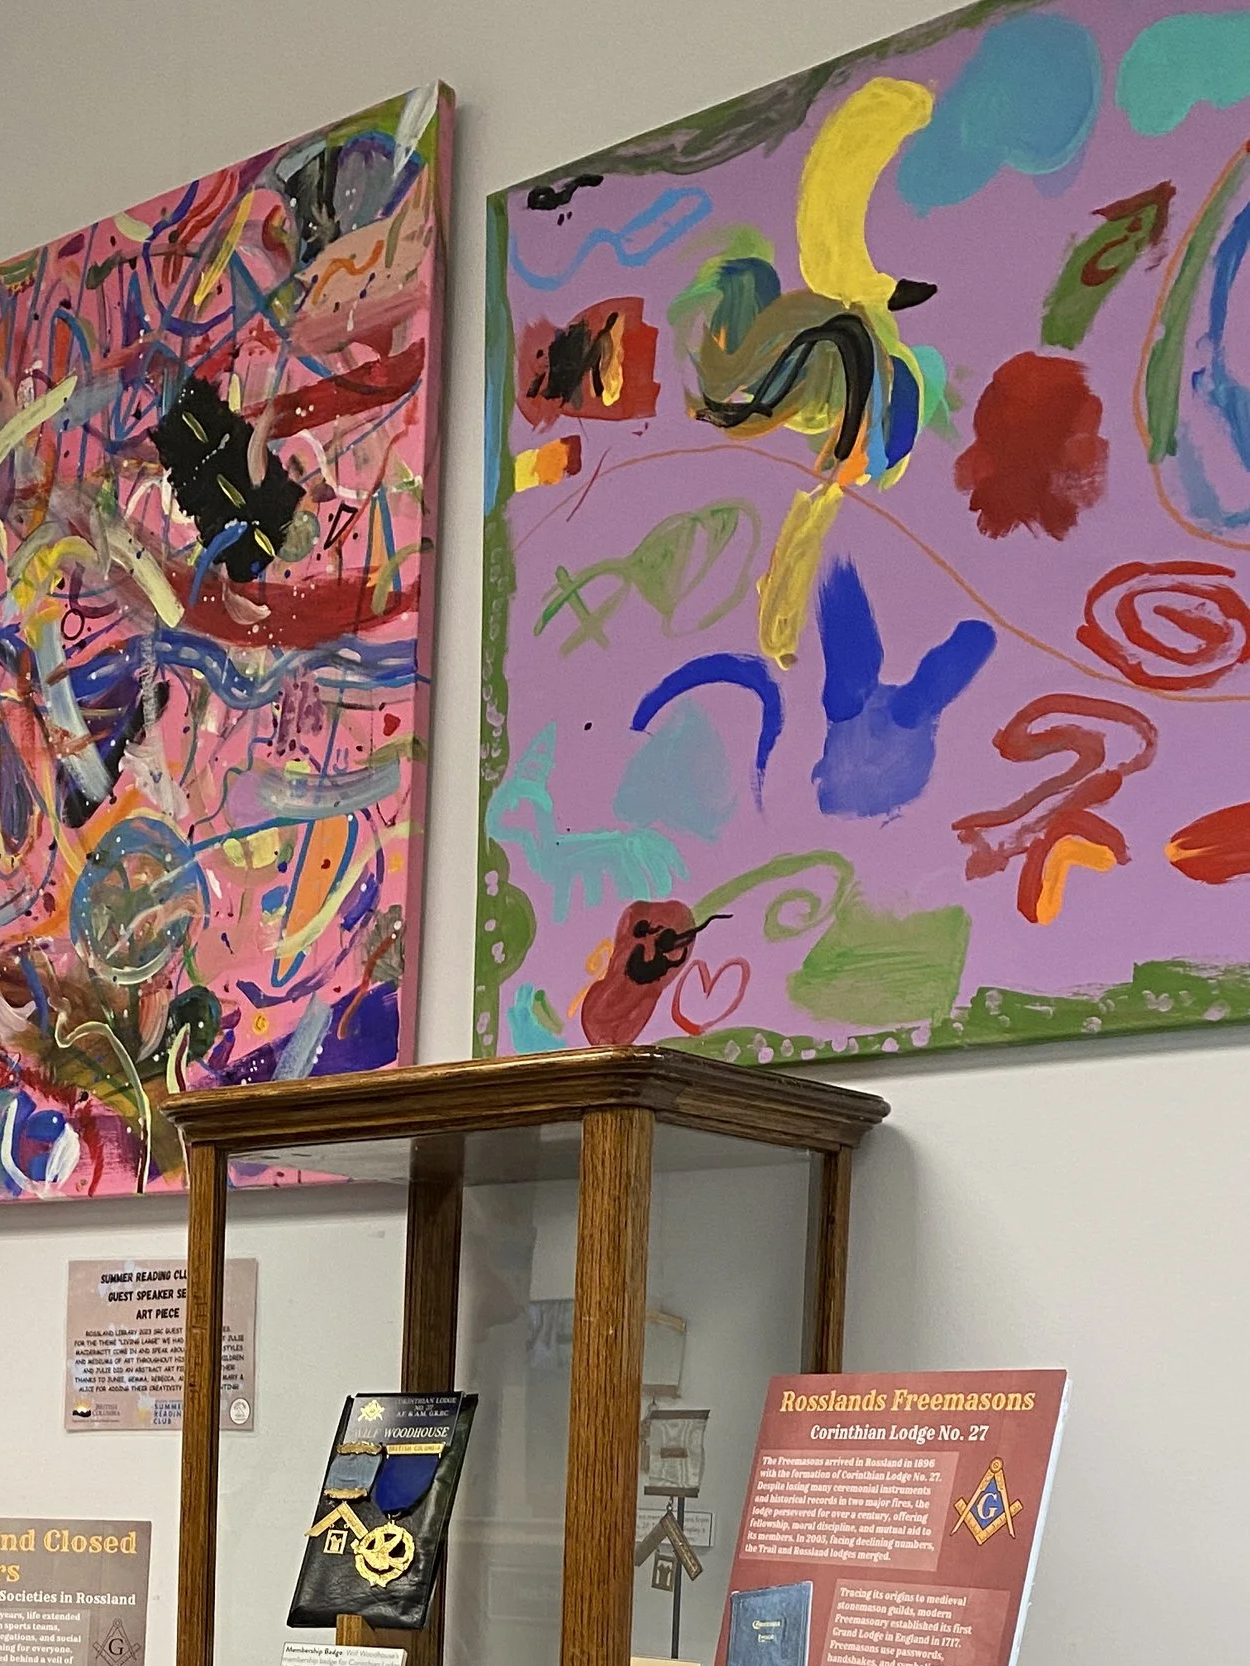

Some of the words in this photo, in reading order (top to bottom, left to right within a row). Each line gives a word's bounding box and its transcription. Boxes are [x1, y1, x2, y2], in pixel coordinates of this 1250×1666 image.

[101, 1273, 133, 1284] SUMMER
[136, 1271, 171, 1282] READING
[108, 1291, 133, 1302] GUEST
[137, 1290, 173, 1301] SPEAKER
[136, 1309, 153, 1319] ART
[156, 1308, 179, 1318] PIECE
[780, 1390, 887, 1412] Rosslands
[890, 1390, 1036, 1412] Freemasons
[384, 1427, 450, 1438] WOODHOUSE
[810, 1424, 886, 1440] Corinthian
[889, 1425, 936, 1444] Lodge
[938, 1426, 964, 1441] No.
[968, 1425, 989, 1441] 27
[763, 1456, 777, 1466] The
[777, 1456, 824, 1466] Freemasons
[824, 1457, 855, 1467] arrived
[854, 1458, 864, 1467] in
[864, 1458, 903, 1468] Rossland
[902, 1458, 913, 1468] in
[913, 1459, 935, 1468] 1896
[760, 1469, 777, 1478] with
[776, 1469, 791, 1479] the
[790, 1469, 831, 1479] formation
[831, 1470, 841, 1480] of
[840, 1470, 886, 1481] Corinthian
[885, 1471, 912, 1483] Lodge
[912, 1472, 927, 1482] No.
[928, 1472, 943, 1482] 27.
[977, 1493, 998, 1520] G
[43, 1529, 137, 1554] Closed
[0, 1590, 56, 1603] Societies
[60, 1591, 73, 1604] in
[76, 1593, 136, 1605] Rossland
[840, 1587, 872, 1601] Tracing
[871, 1590, 884, 1600] its
[883, 1591, 915, 1605] origins
[914, 1593, 925, 1603] to
[925, 1594, 967, 1607] medieval
[0, 1612, 24, 1621] years,
[26, 1611, 40, 1620] life
[41, 1611, 81, 1621] extended
[837, 1600, 888, 1614] stonemason
[887, 1604, 916, 1618] guilds,
[916, 1607, 953, 1619] modern
[3, 1621, 31, 1632] sports
[31, 1622, 61, 1633] teams,
[835, 1613, 889, 1630] Freemasonry
[889, 1618, 939, 1632] established
[939, 1623, 952, 1633] its
[952, 1624, 972, 1635] first
[39, 1633, 55, 1642] and
[56, 1634, 82, 1643] social
[832, 1626, 858, 1638] Grand
[857, 1629, 884, 1643] Lodge
[883, 1631, 894, 1642] in
[894, 1632, 930, 1647] England
[930, 1636, 940, 1646] in
[940, 1637, 963, 1649] 1717.
[108, 1638, 124, 1656] G
[286, 1647, 322, 1656] Membership
[830, 1639, 880, 1654] Freemasons
[879, 1647, 895, 1656] use
[895, 1646, 946, 1663] passwords,
